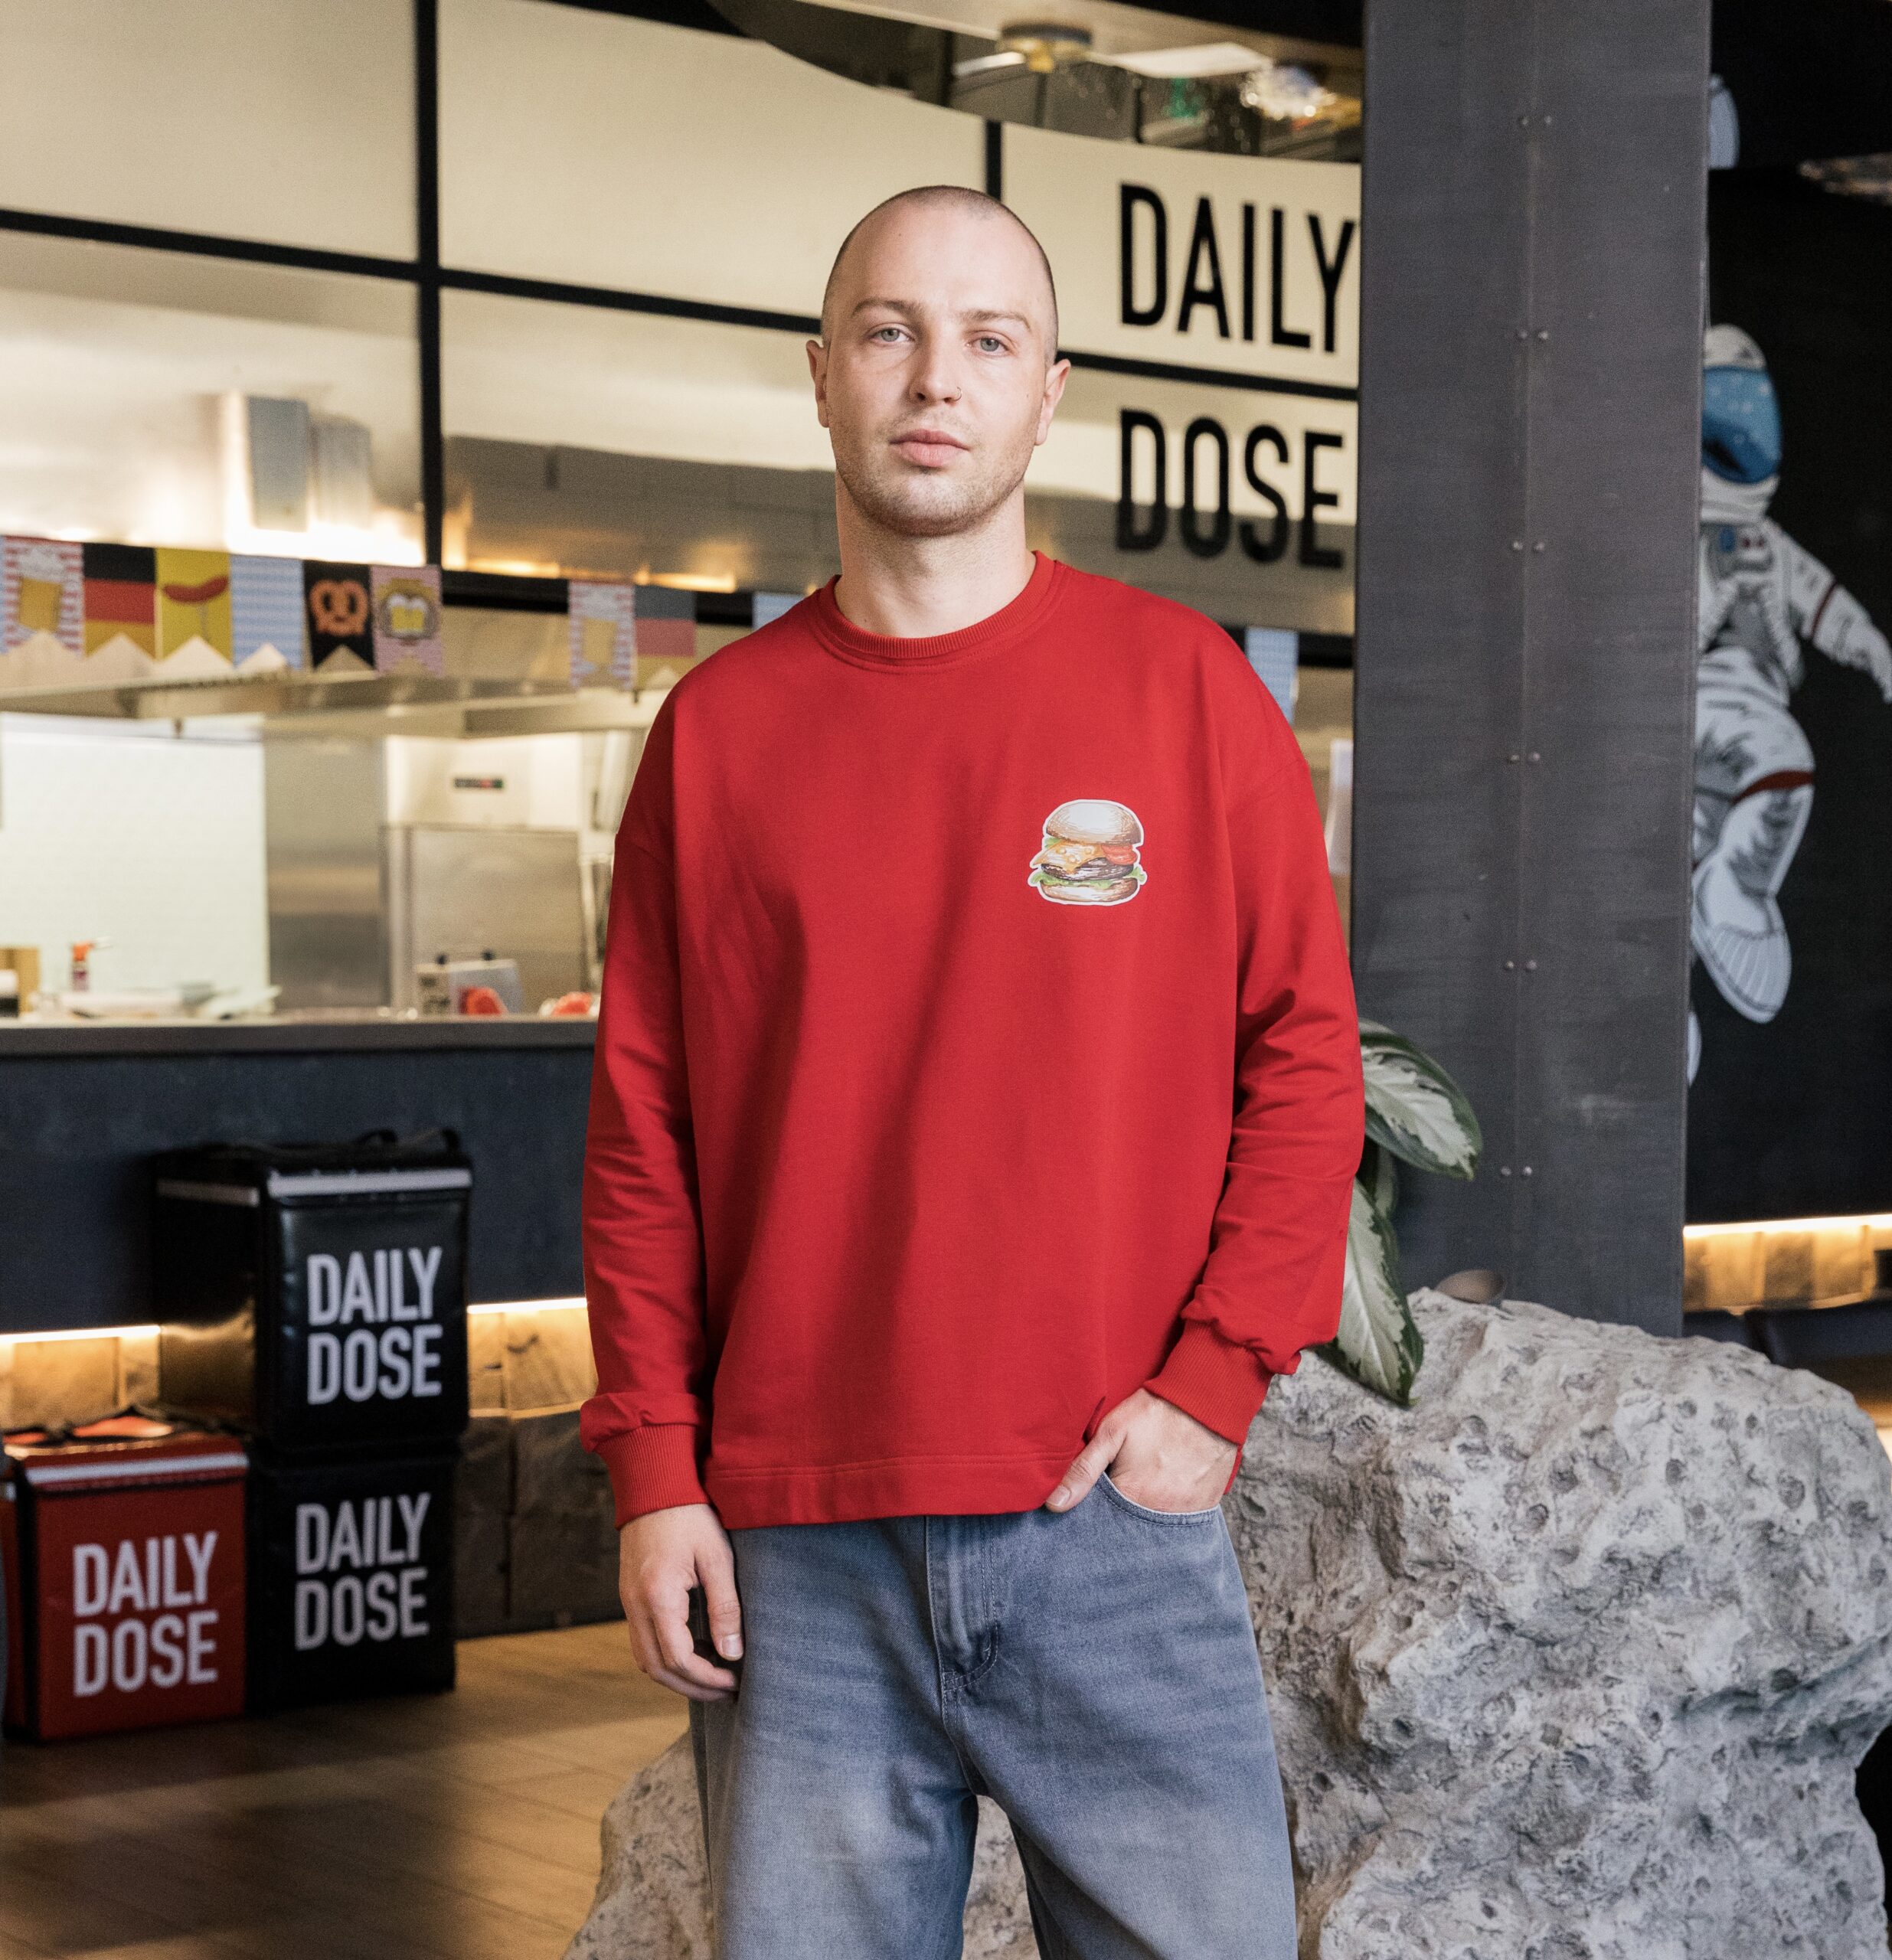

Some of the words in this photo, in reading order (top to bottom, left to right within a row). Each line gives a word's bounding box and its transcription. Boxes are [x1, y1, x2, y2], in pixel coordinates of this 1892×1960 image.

[1120, 181, 1356, 353] DAILY
[1116, 408, 1344, 569] DOSE
[308, 1246, 443, 1325] DAILY
[308, 1325, 443, 1406] DOSE
[74, 1532, 217, 1618] DAILY
[296, 1493, 431, 1576] DAILY
[296, 1568, 429, 1651] DOSE
[74, 1611, 219, 1699] DOSE
